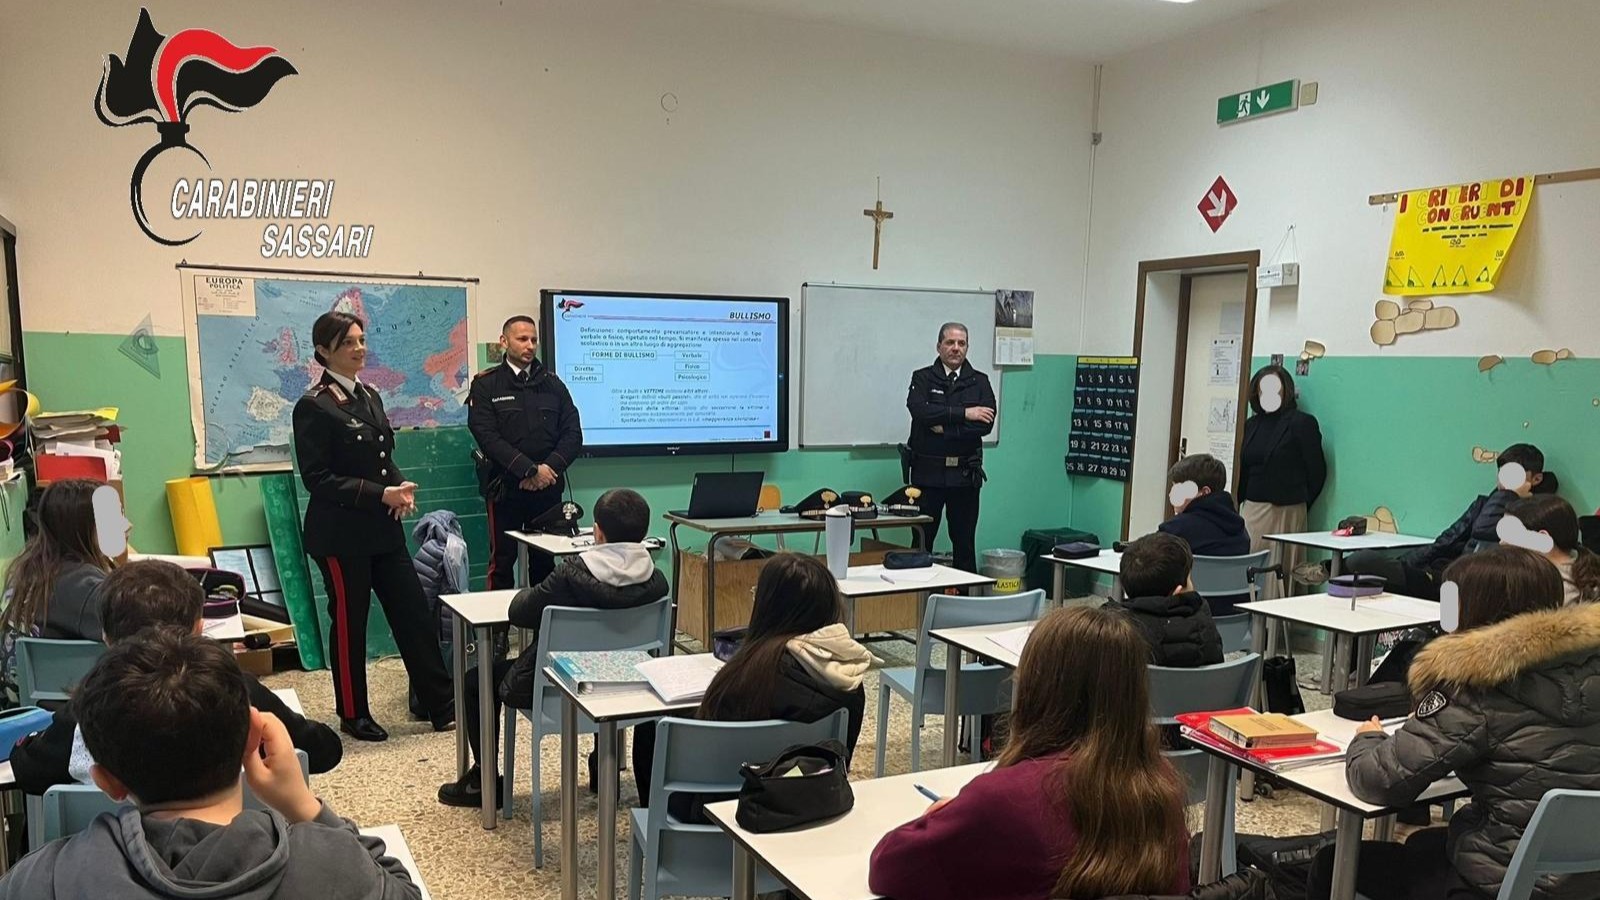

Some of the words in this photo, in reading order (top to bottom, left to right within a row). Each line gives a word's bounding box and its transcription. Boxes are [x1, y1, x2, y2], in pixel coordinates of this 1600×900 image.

[1400, 194, 1408, 213] I
[1416, 182, 1488, 210] CRITERI
[1500, 178, 1525, 197] DI
[1089, 375, 1093, 383] 2
[1098, 375, 1102, 383] 3
[1107, 398, 1113, 407] 10
[1116, 399, 1122, 407] 11
[1074, 419, 1082, 427] 13
[1094, 420, 1102, 428] 15
[1071, 440, 1078, 448] 19
[1091, 442, 1100, 450] 21
[1102, 443, 1109, 451] 22
[1112, 444, 1119, 452] 23
[1110, 467, 1117, 475] 29
